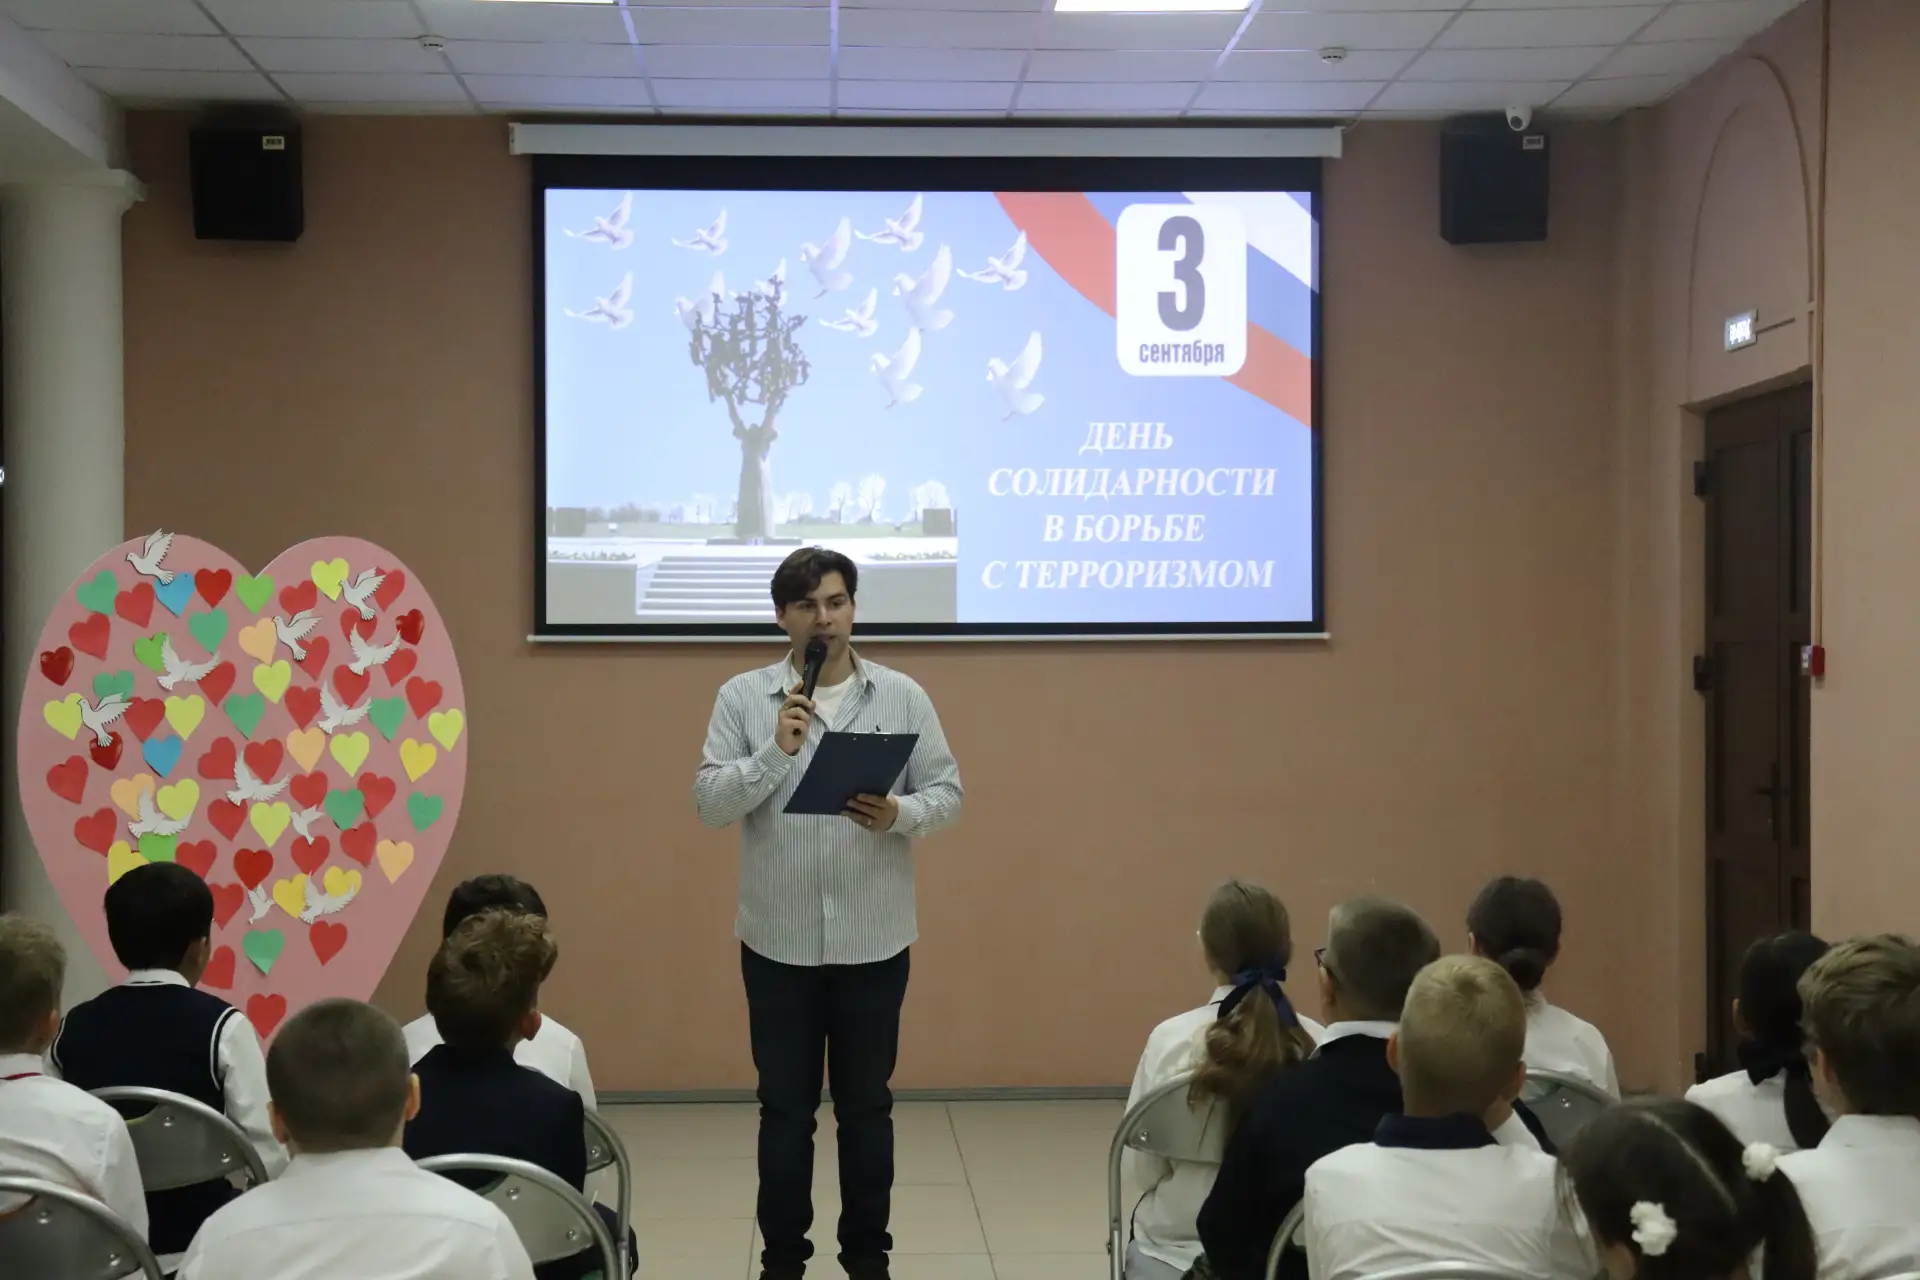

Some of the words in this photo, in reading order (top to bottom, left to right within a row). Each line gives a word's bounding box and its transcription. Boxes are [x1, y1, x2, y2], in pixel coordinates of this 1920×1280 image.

[1158, 215, 1205, 331] 3
[1139, 340, 1225, 366] сентября
[1079, 421, 1174, 455] ДЕНЬ
[987, 468, 1277, 502] СОЛИДАРНОСТИ
[1043, 515, 1065, 542] В
[1073, 514, 1205, 543] БОРЬБЕ
[982, 561, 1007, 589] С
[1016, 559, 1274, 588] ТЕРРОРИЗМОМ
